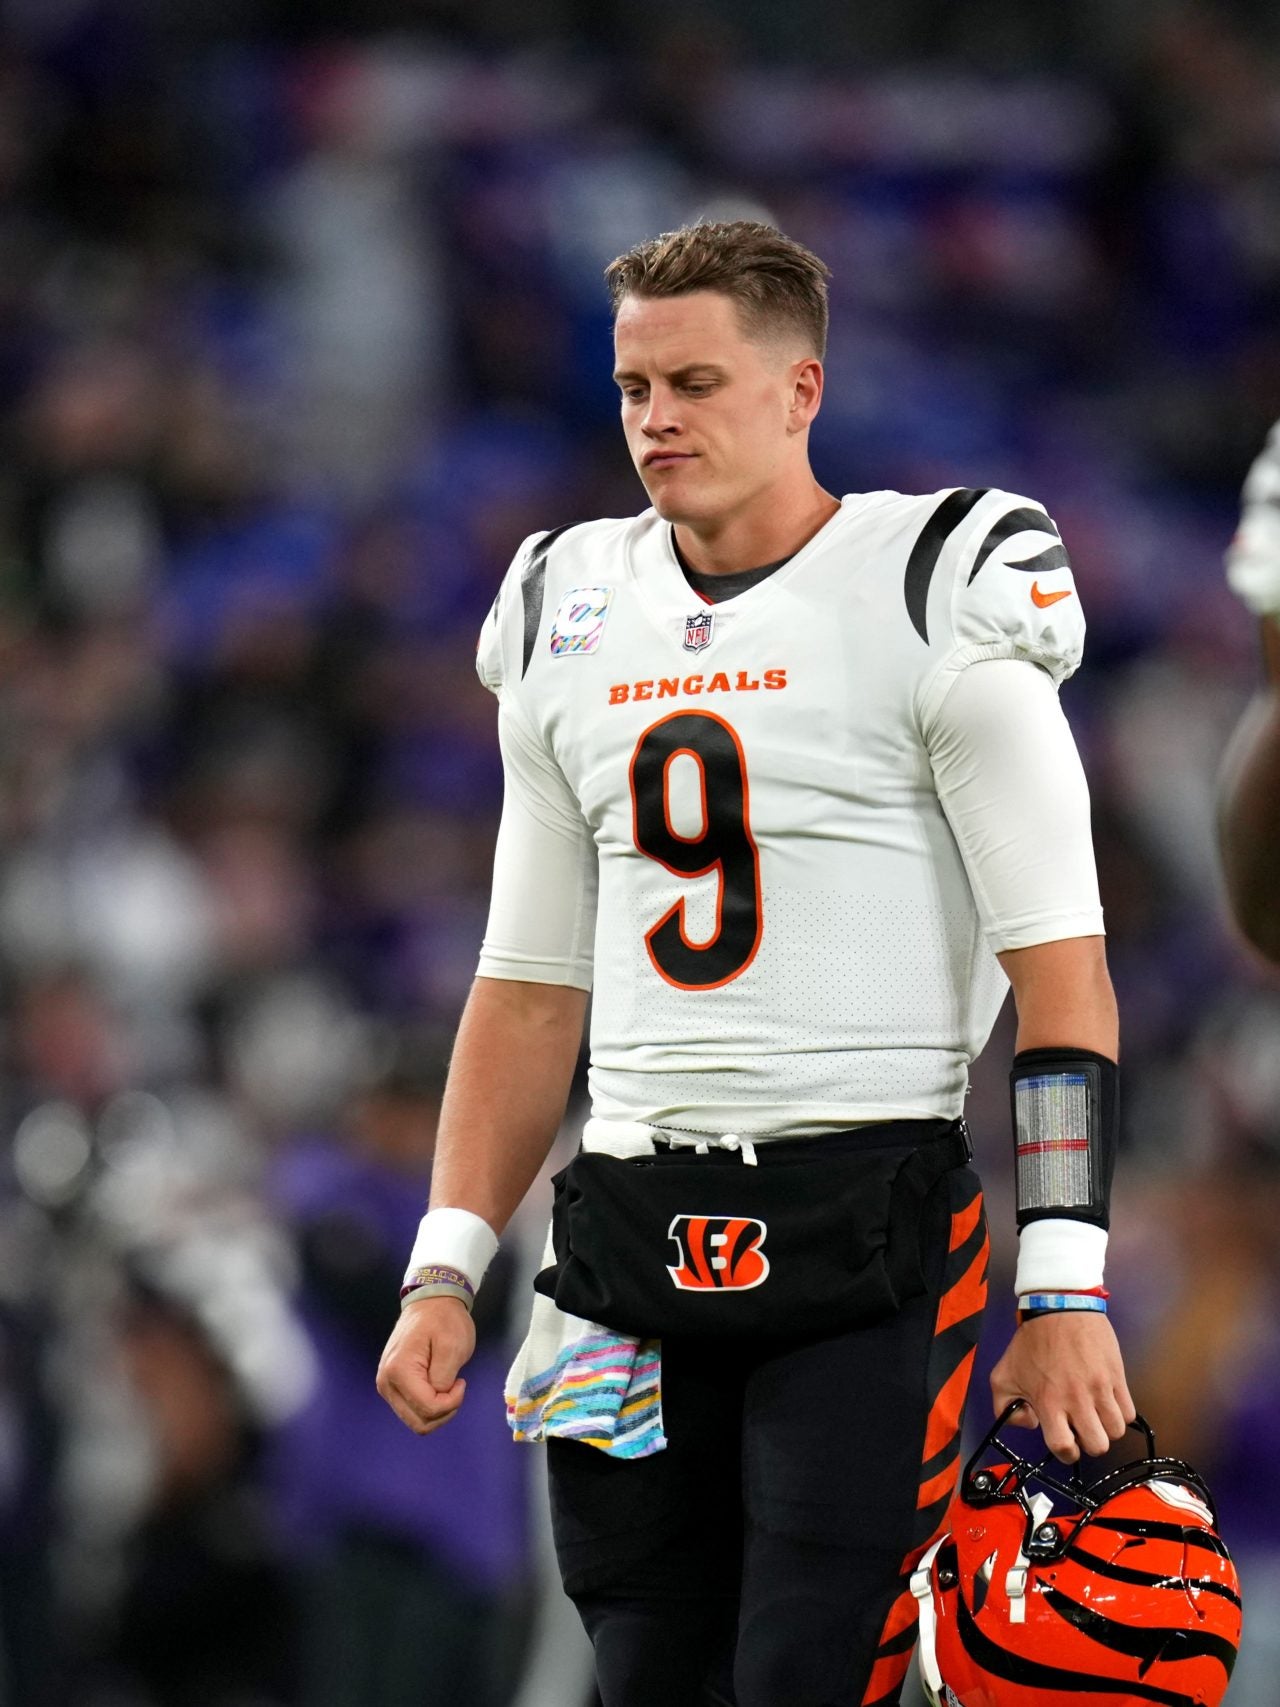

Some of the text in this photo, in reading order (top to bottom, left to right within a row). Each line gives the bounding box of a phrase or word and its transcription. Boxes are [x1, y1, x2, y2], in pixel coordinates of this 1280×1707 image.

[687, 627, 707, 645] NFL
[608, 668, 788, 705] BENGALS
[628, 708, 764, 991] 9
